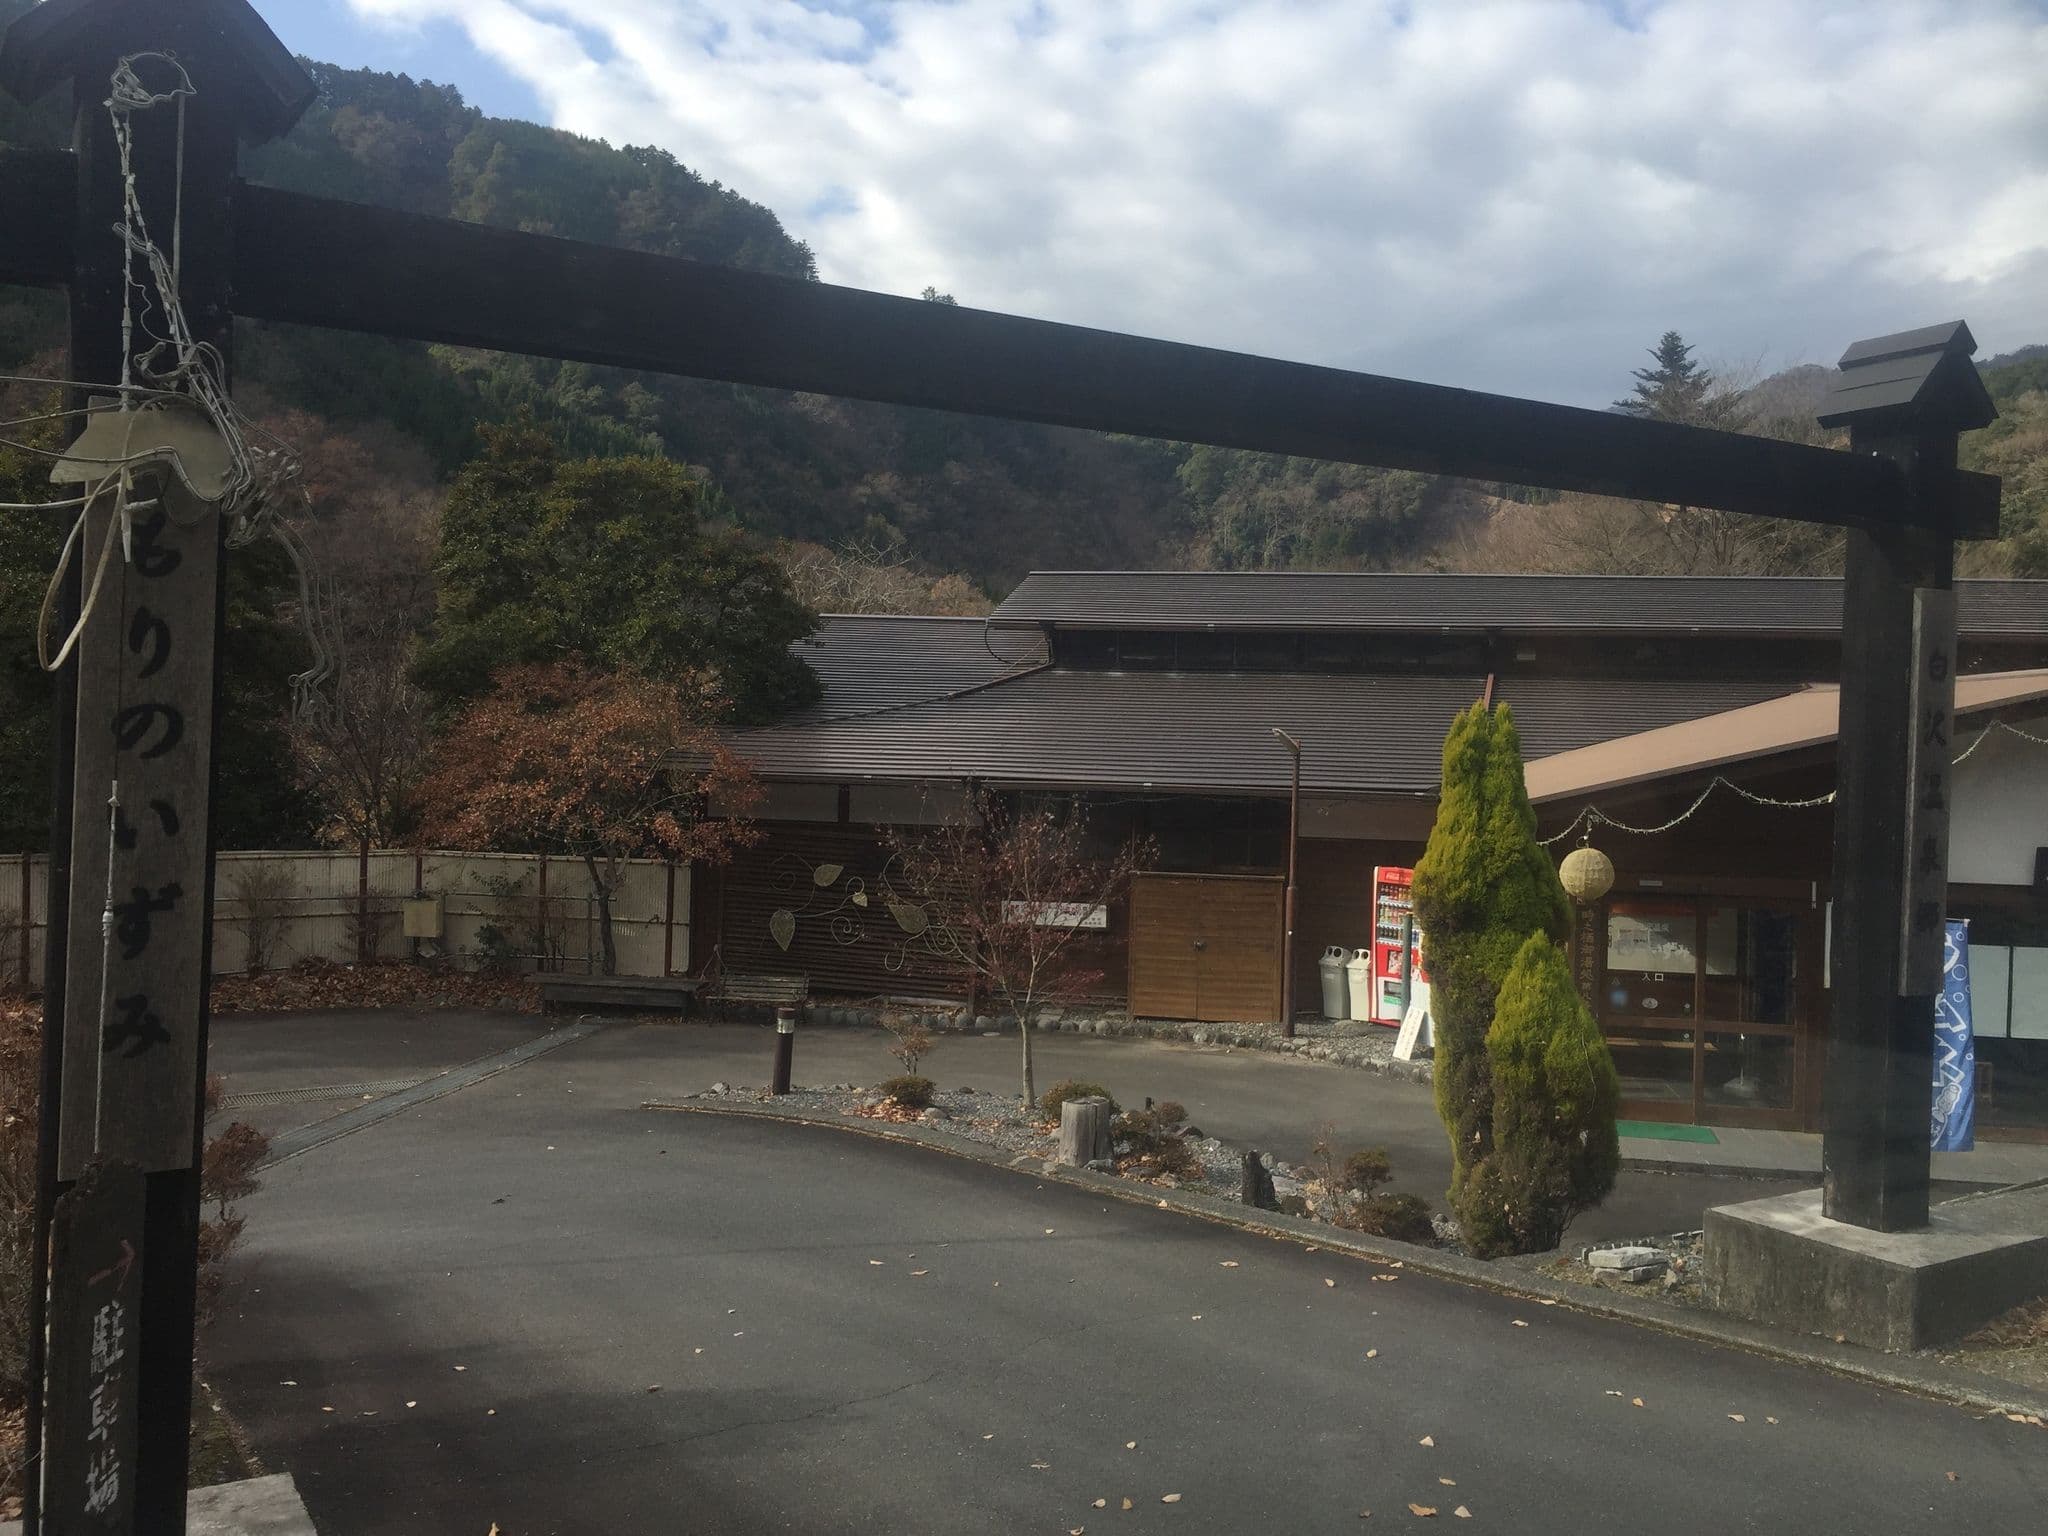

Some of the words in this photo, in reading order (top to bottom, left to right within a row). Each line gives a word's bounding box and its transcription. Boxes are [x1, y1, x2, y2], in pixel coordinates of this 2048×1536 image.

[103, 506, 183, 1059] もりのいずみ
[1641, 972, 1664, 982] 入口
[84, 1300, 124, 1513] 駐車場
